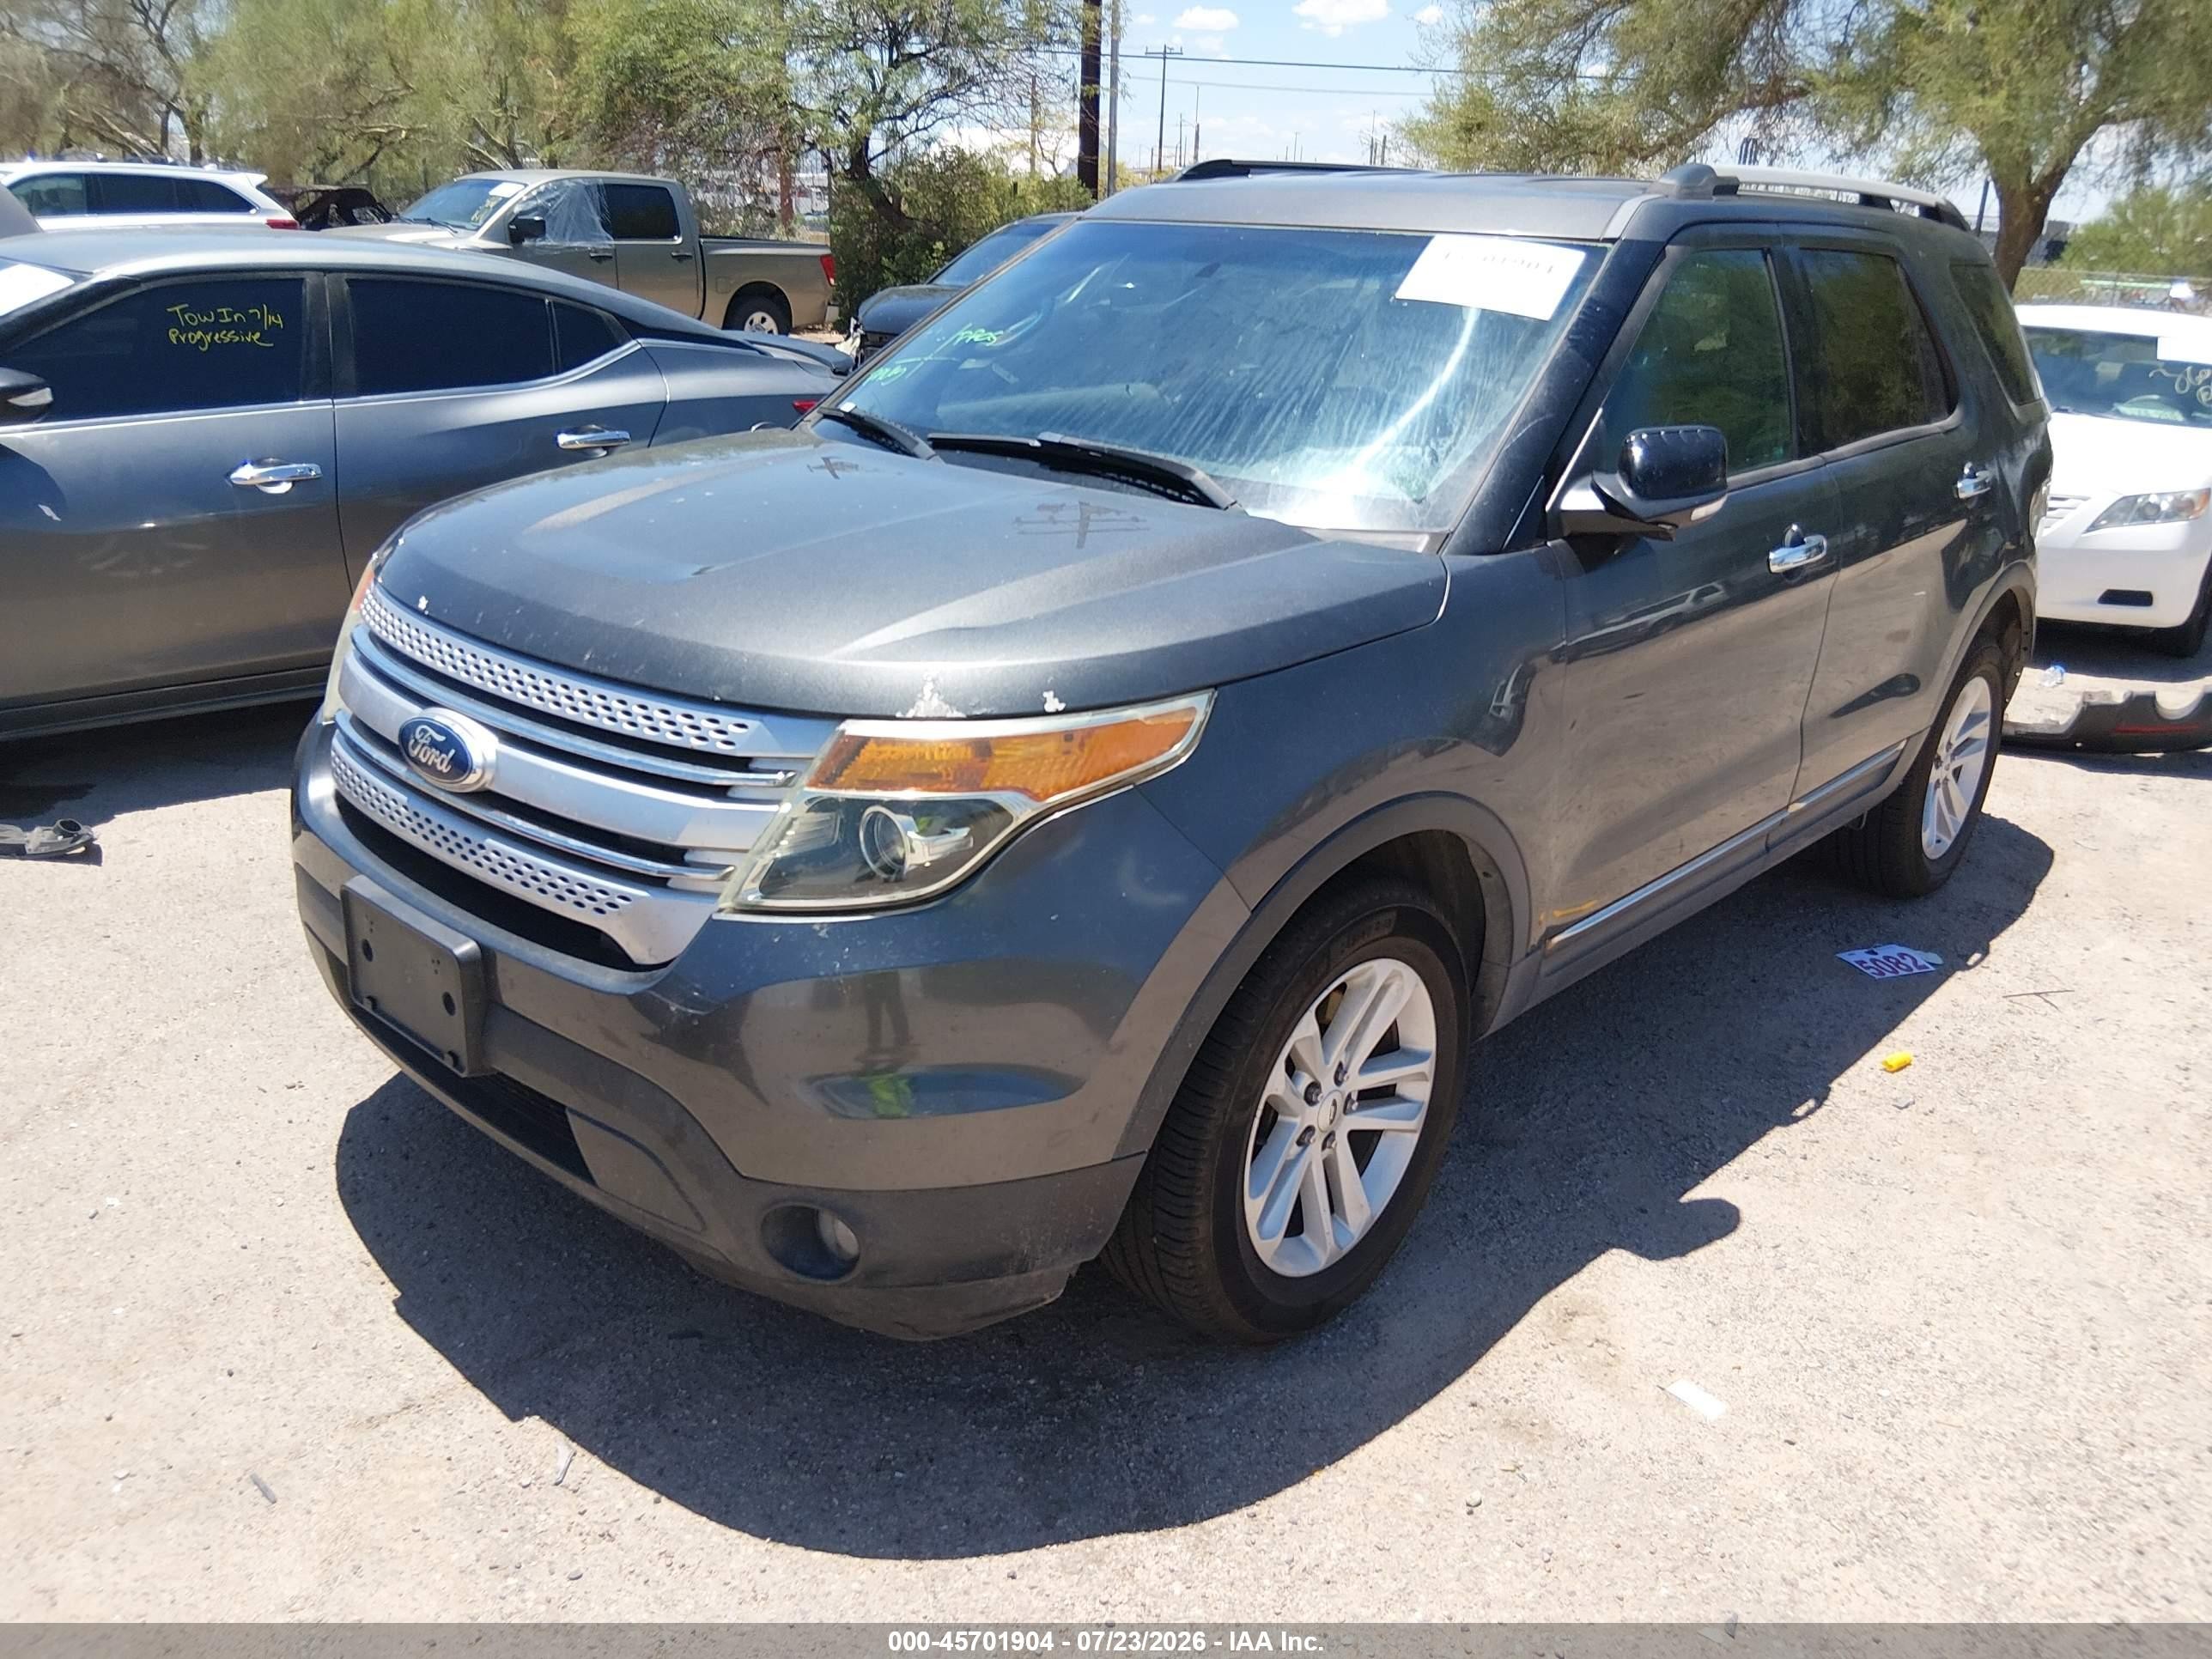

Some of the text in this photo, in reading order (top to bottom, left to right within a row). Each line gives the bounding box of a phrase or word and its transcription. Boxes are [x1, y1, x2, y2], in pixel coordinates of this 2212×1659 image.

[248, 304, 283, 331] 7/14
[168, 328, 275, 351] Progressive
[408, 725, 456, 773] Ford
[1855, 951, 1930, 976] 5082
